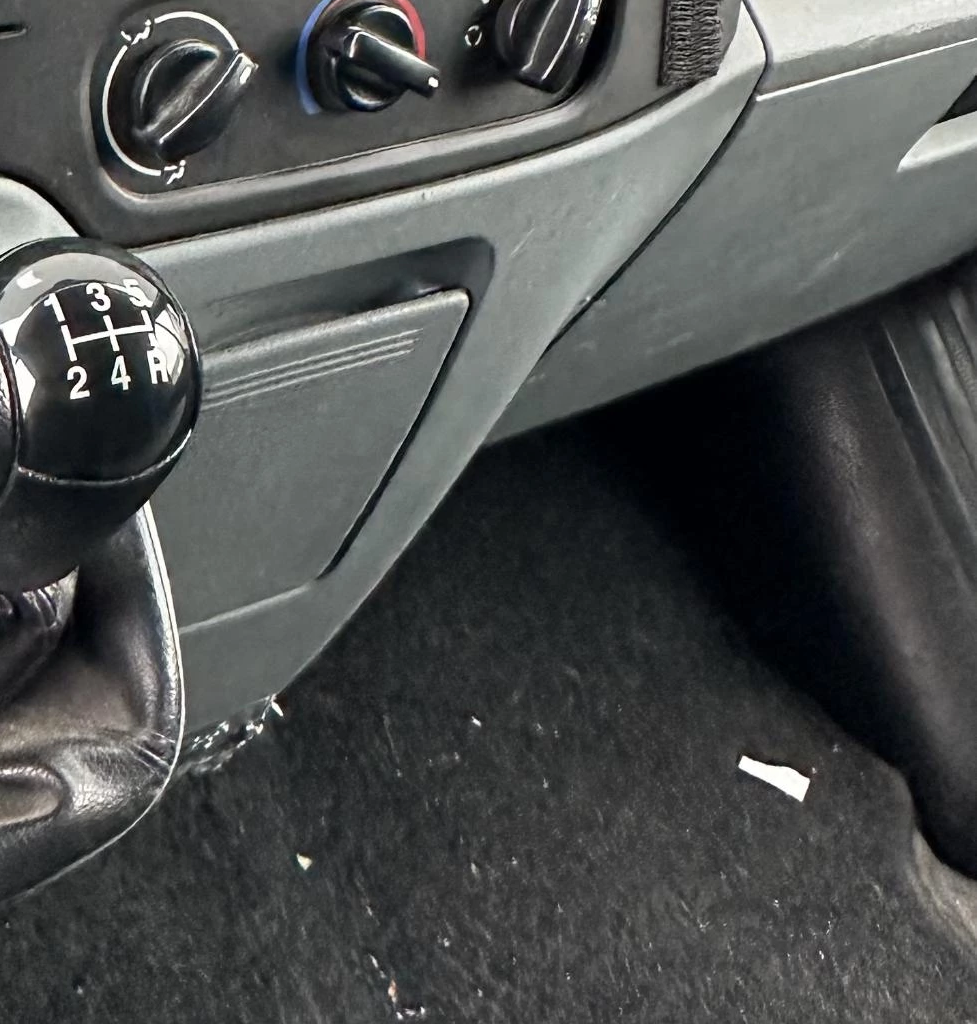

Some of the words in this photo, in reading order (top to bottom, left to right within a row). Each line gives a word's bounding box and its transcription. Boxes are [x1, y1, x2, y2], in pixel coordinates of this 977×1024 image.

[44, 293, 66, 322] 1
[85, 282, 112, 312] 3
[122, 278, 153, 308] 5
[66, 365, 91, 400] 2
[111, 355, 131, 391] 4
[147, 348, 169, 385] R
